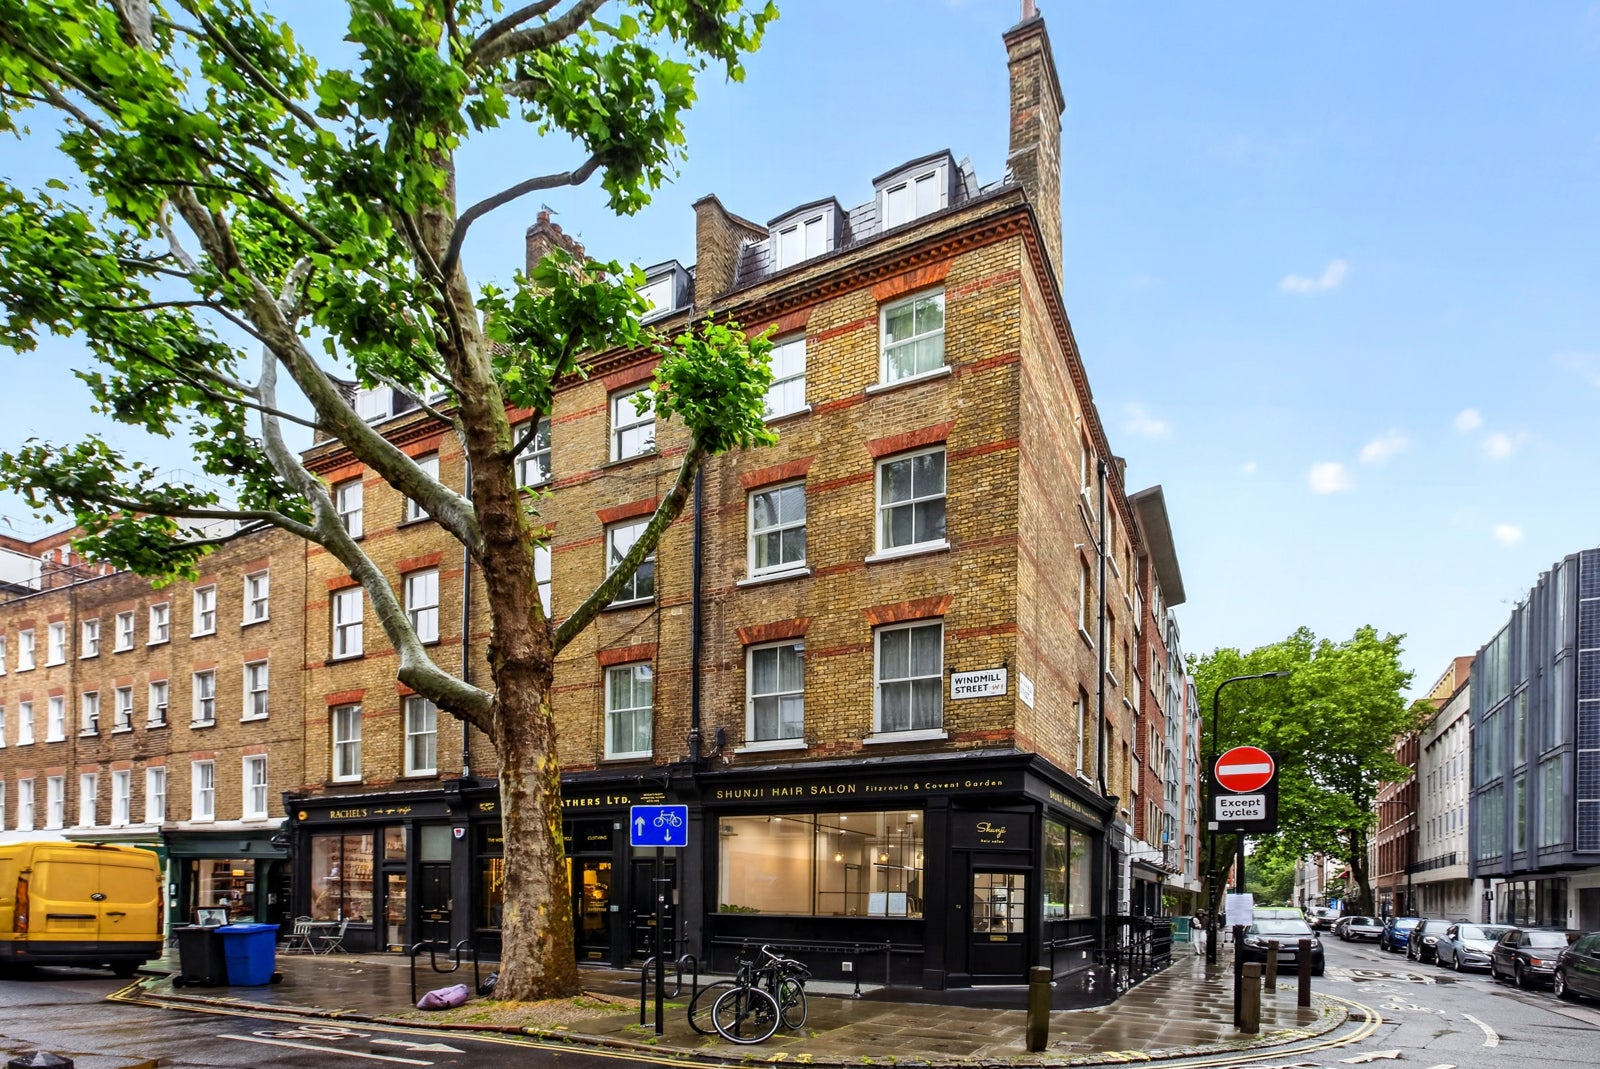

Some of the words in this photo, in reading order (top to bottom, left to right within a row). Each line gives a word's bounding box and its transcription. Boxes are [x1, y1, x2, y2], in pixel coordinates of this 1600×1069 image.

[954, 673, 1002, 685] WINDMILL
[955, 684, 989, 694] STREET
[716, 788, 764, 799] SHUNJI
[772, 786, 803, 796] HAIR
[810, 784, 856, 795] SALON
[865, 784, 909, 792] Fitzrovia
[925, 781, 959, 789] Covent
[964, 779, 1003, 787] Garden
[1220, 798, 1261, 807] Except
[329, 808, 368, 819] RACHEL'S
[1222, 808, 1259, 818] cycles
